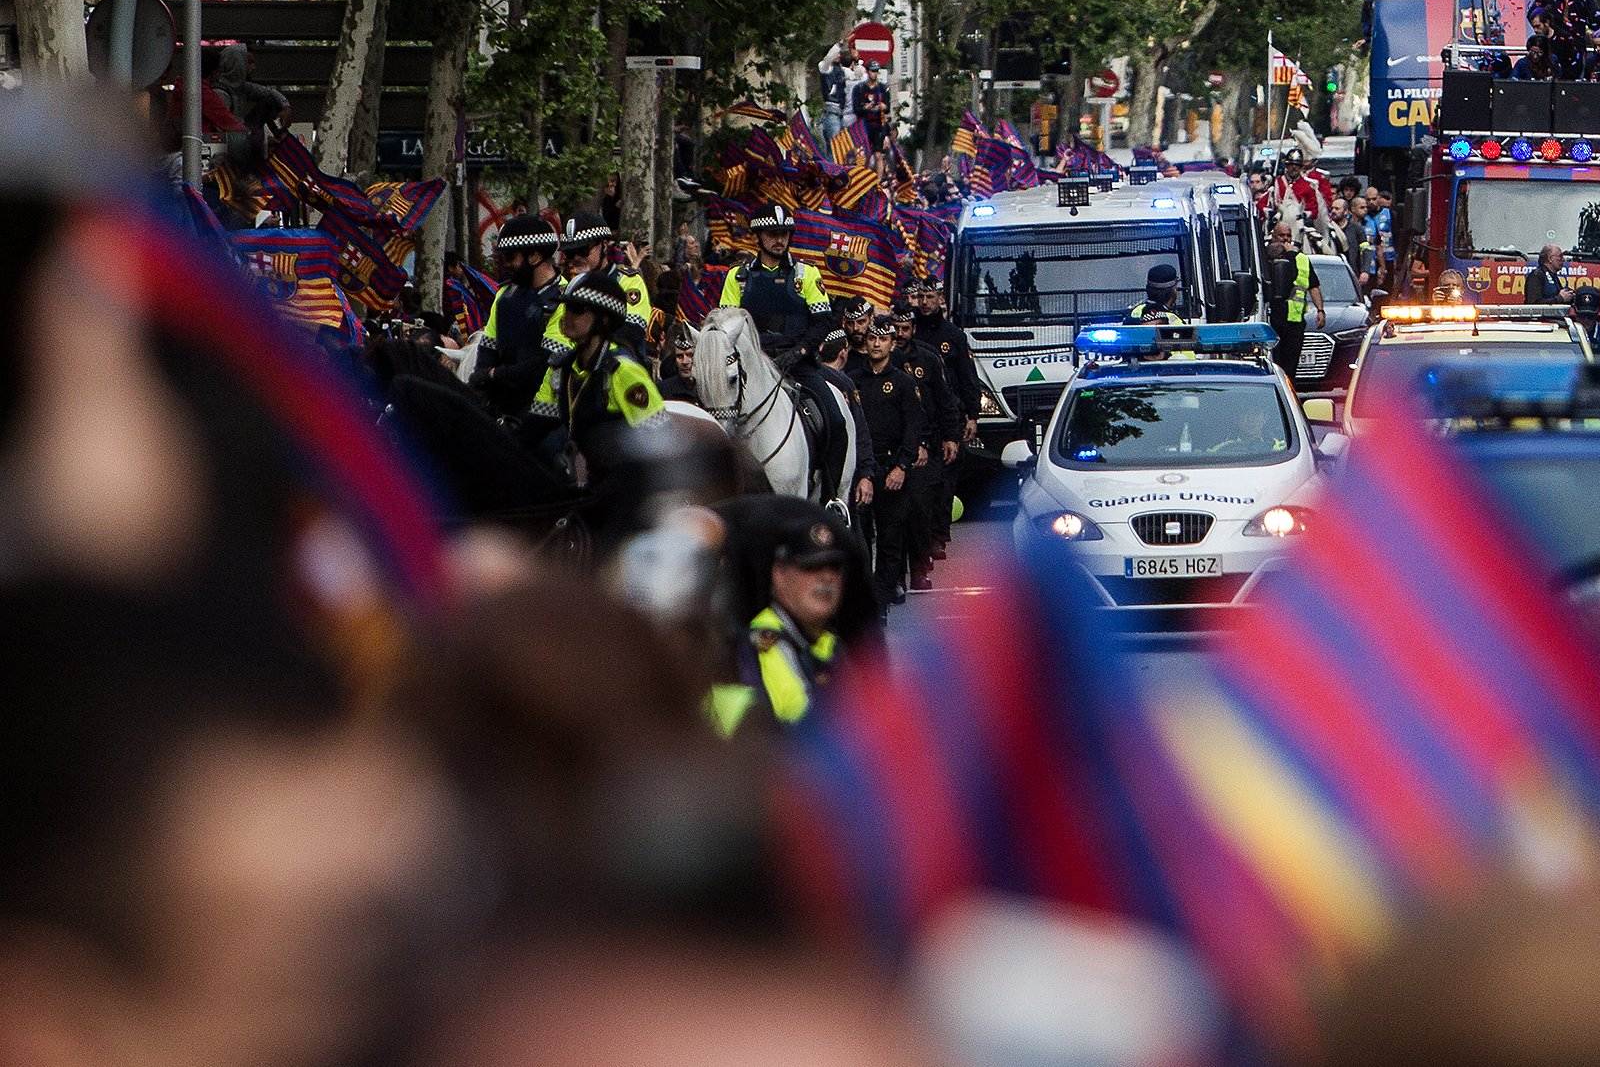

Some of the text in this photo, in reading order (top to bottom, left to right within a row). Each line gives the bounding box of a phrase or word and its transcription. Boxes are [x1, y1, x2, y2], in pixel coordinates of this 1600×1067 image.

[1388, 88, 1402, 99] LA
[1498, 266, 1508, 274] LA
[1179, 492, 1255, 505] Urbana
[1136, 557, 1217, 575] 6845 HGZ
